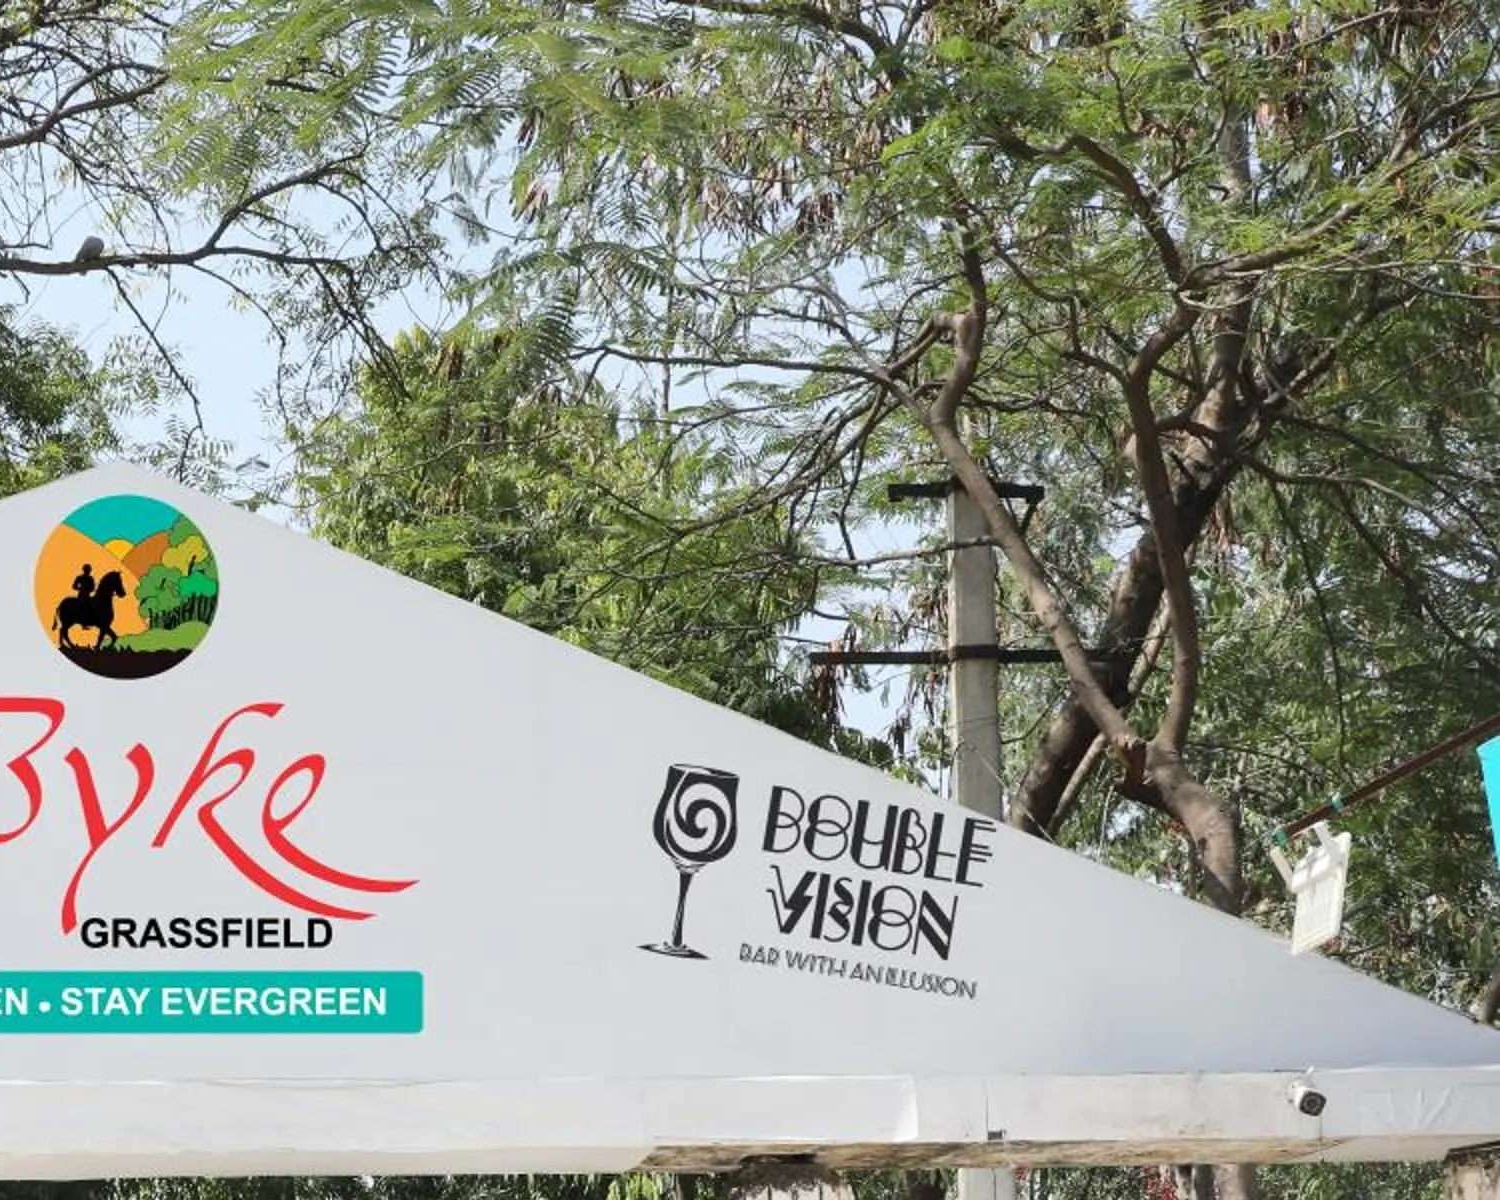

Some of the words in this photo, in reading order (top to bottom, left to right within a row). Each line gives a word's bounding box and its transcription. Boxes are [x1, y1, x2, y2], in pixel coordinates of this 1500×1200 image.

[762, 785, 997, 888] DOUBLE
[766, 865, 959, 960] VISION
[80, 917, 333, 949] GRASSFIELD
[739, 943, 781, 966] BAR
[785, 949, 848, 978] WITH
[61, 987, 150, 1016] STAY
[162, 987, 387, 1016] EVERGREEN
